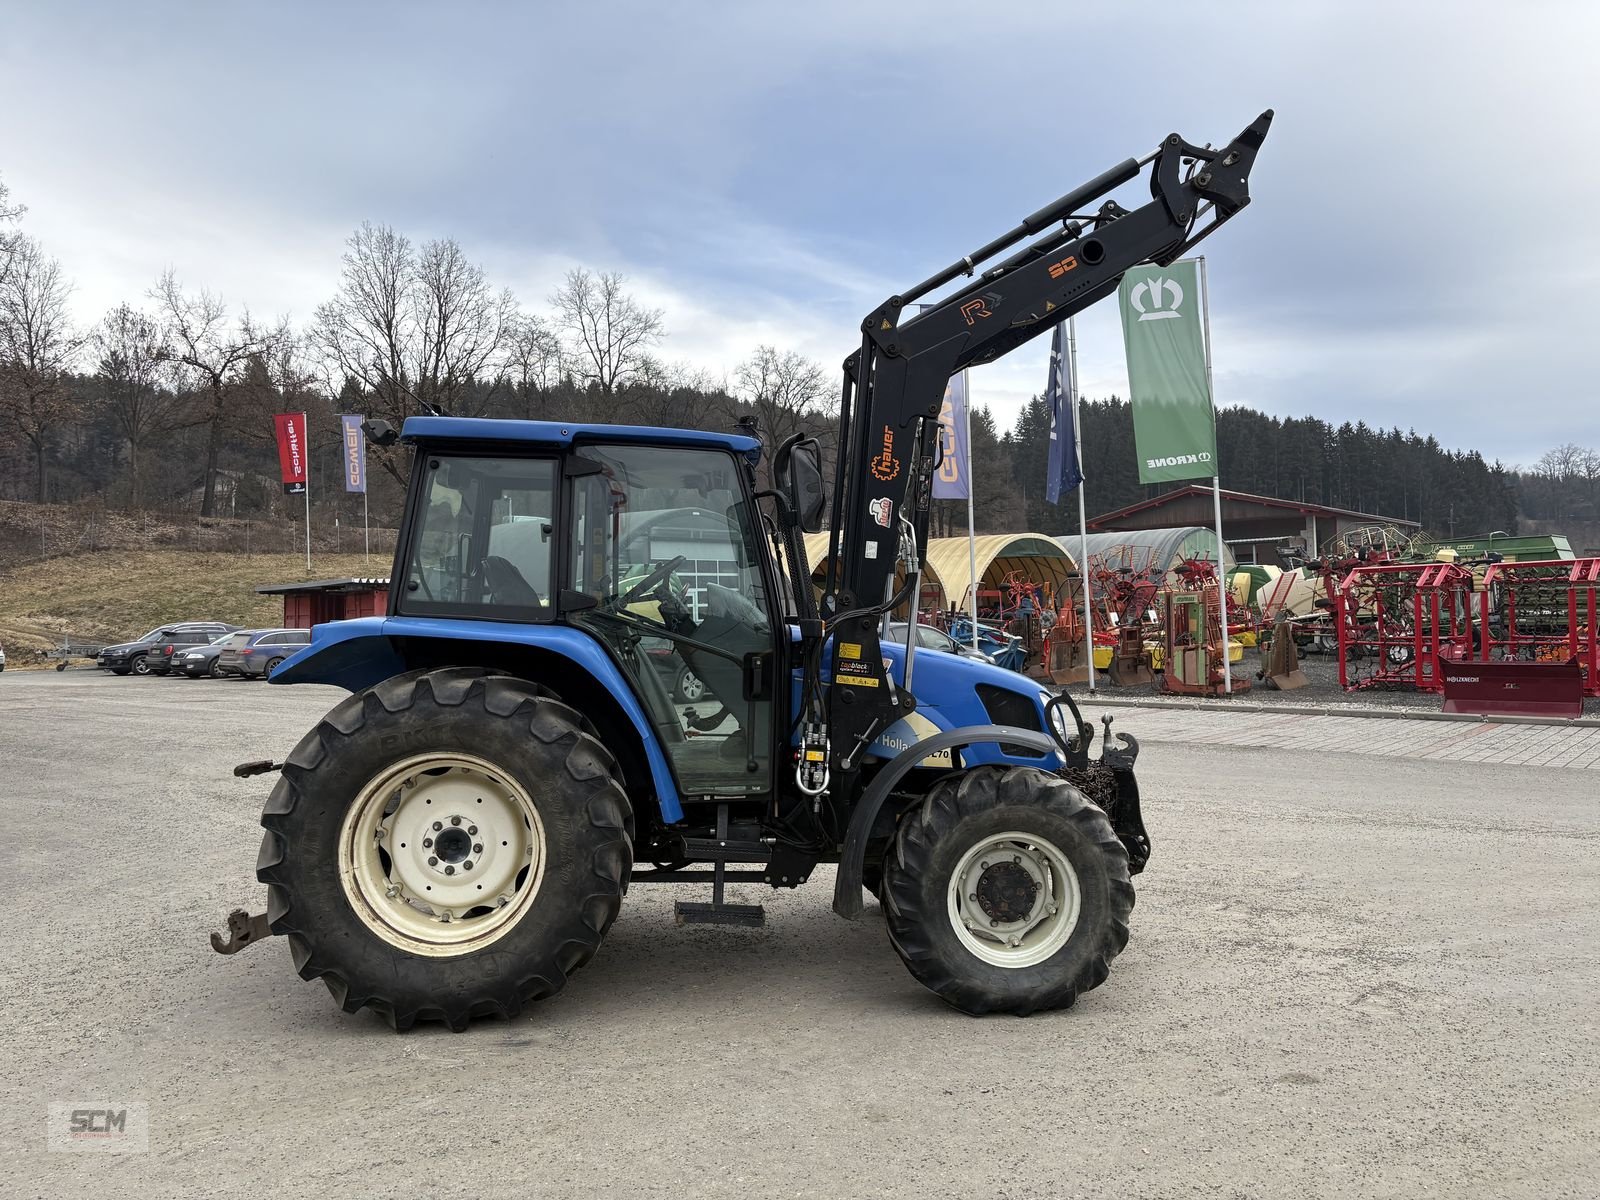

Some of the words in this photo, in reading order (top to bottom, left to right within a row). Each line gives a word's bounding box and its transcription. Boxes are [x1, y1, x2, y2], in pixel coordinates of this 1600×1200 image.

[877, 424, 895, 473] hauer
[882, 734, 912, 752] Holla
[927, 750, 949, 759] L70
